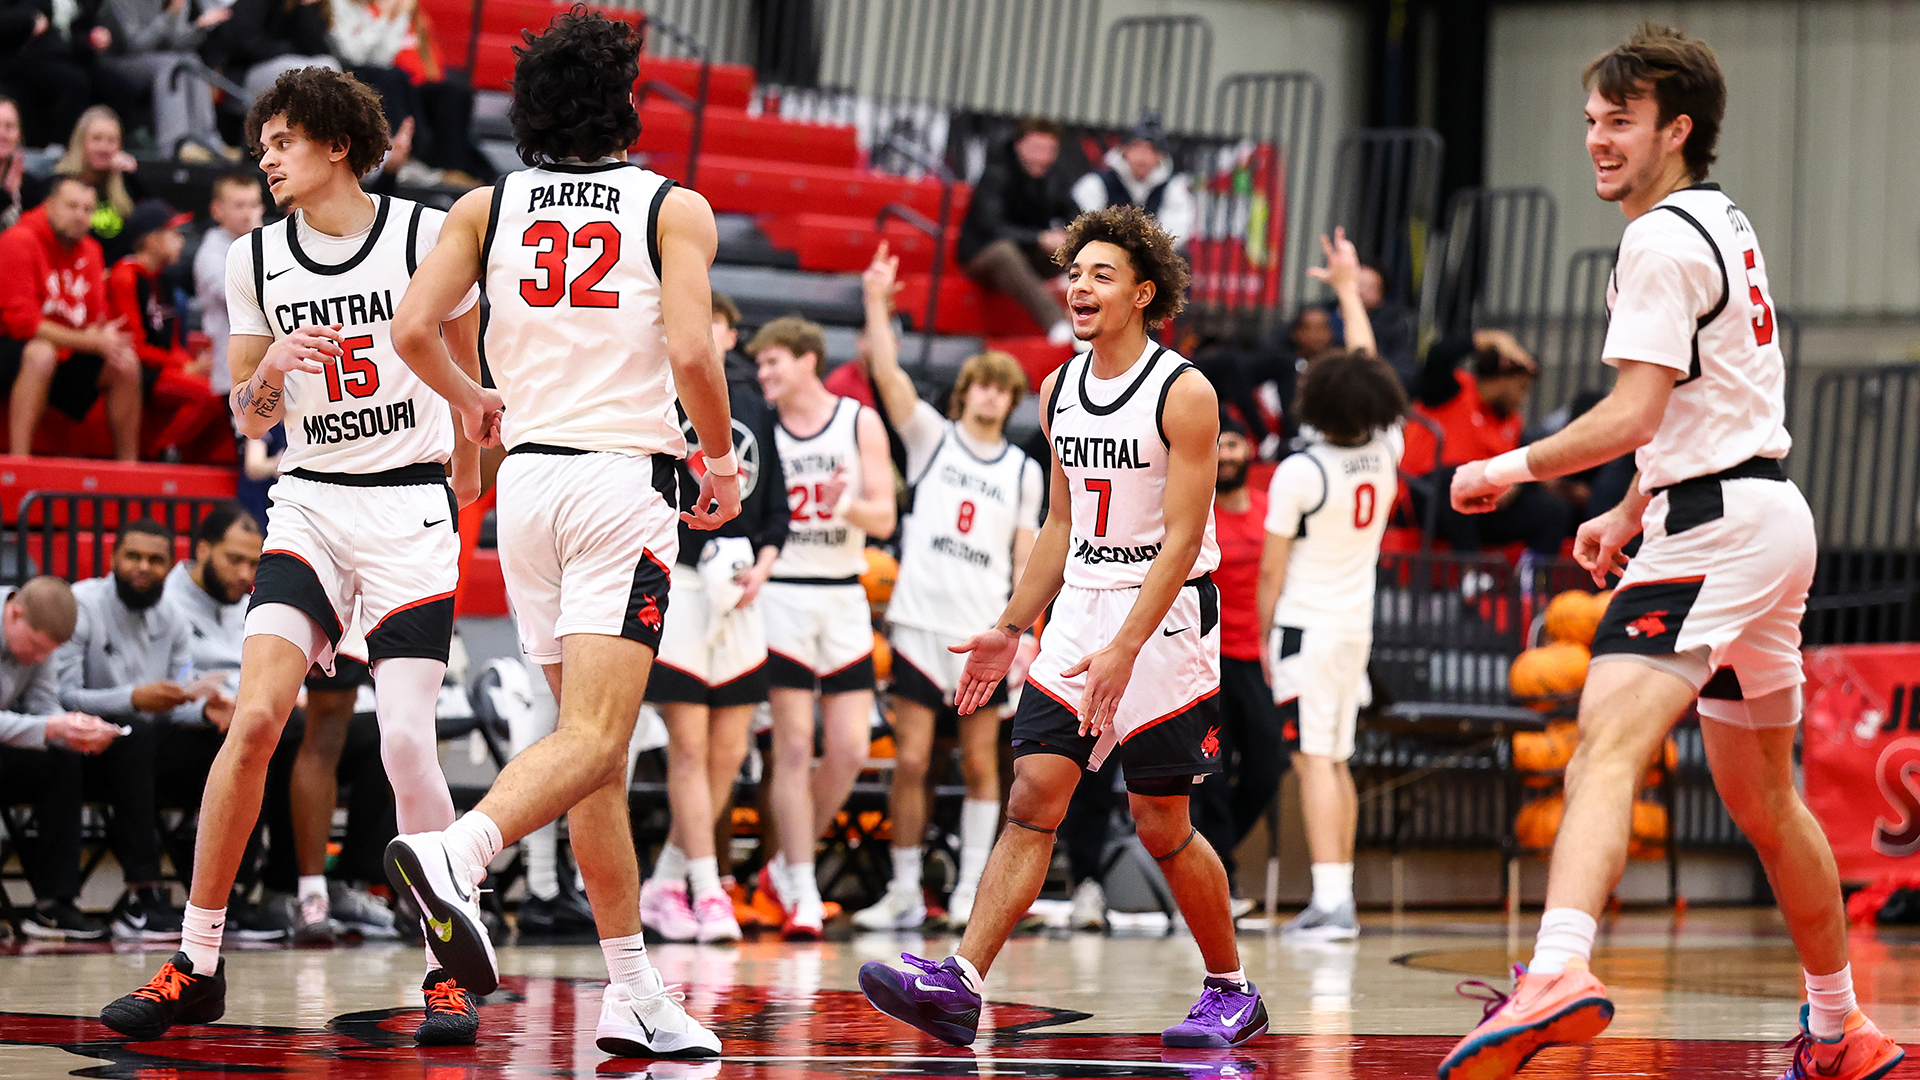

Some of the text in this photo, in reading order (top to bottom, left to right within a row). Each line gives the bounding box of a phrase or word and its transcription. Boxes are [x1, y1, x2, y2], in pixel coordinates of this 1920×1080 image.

[527, 182, 620, 215] PARKER
[519, 219, 622, 309] 32
[1743, 248, 1774, 346] 5
[317, 333, 381, 403] 15
[303, 398, 416, 445] MISSOURI
[957, 500, 976, 536] 8
[1084, 478, 1112, 538] 7
[1354, 482, 1376, 529] 0
